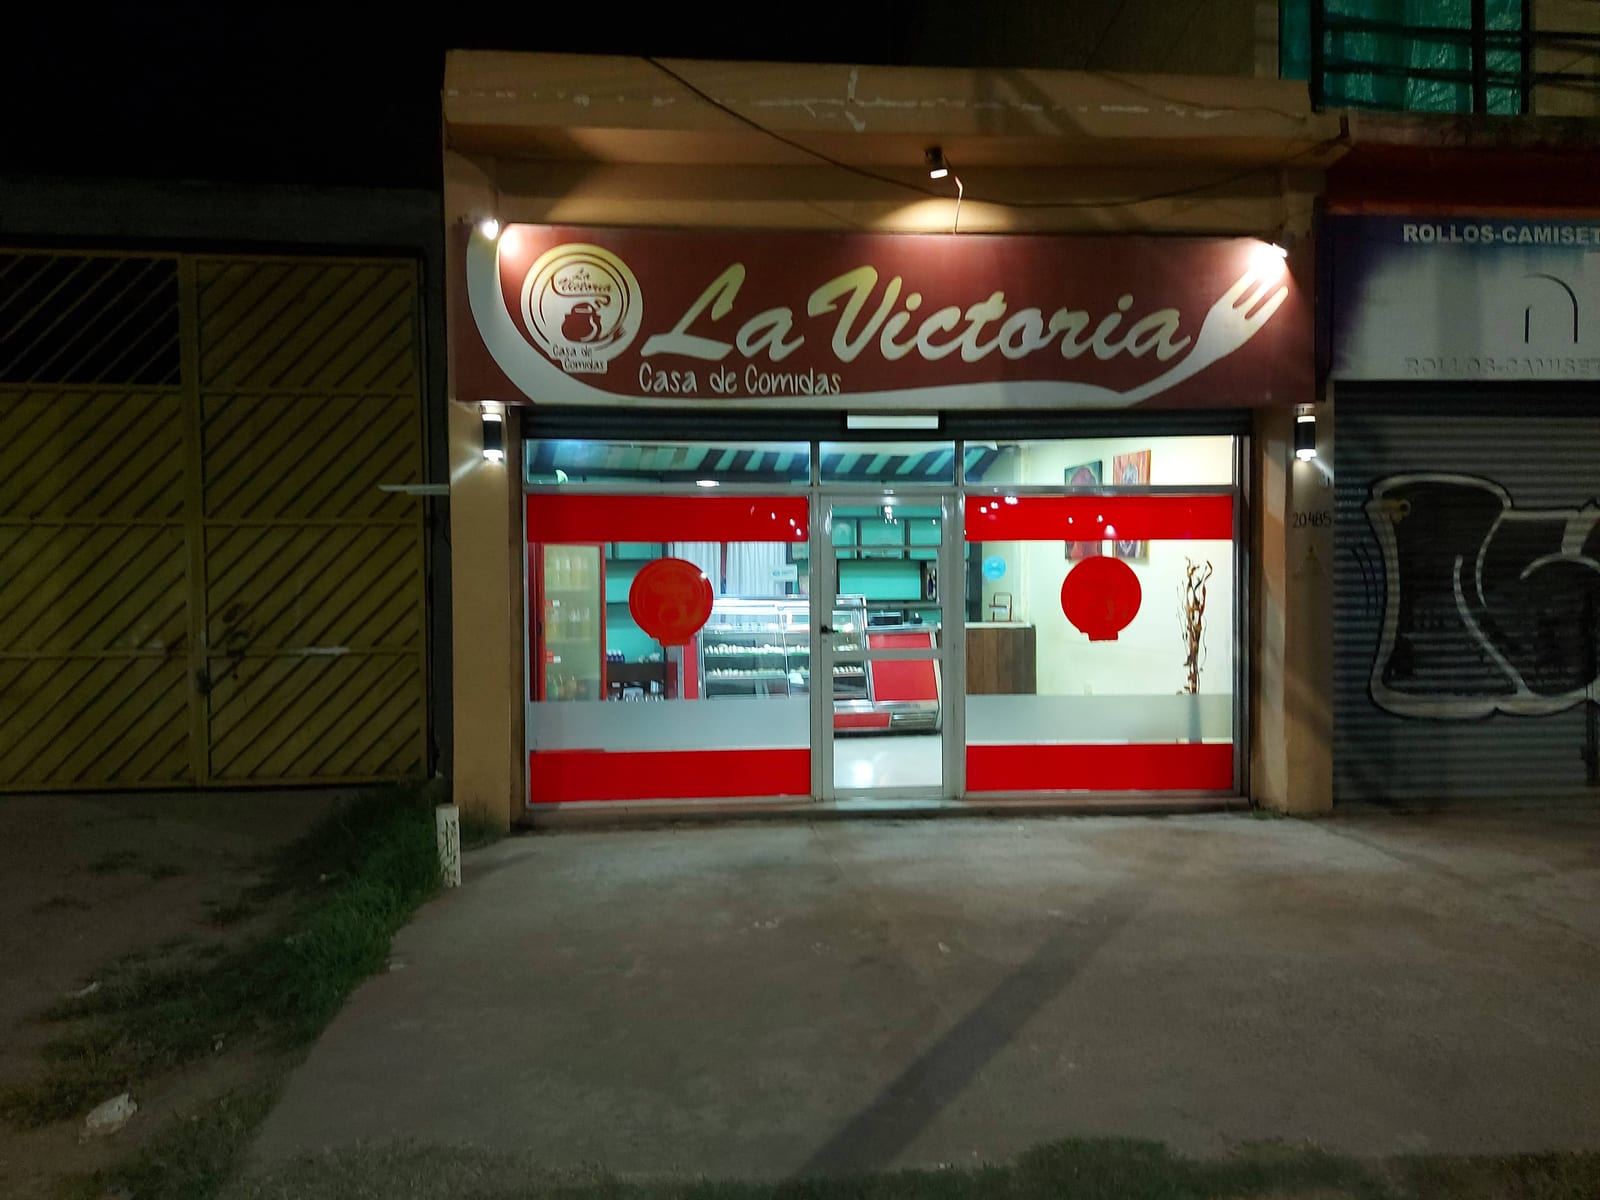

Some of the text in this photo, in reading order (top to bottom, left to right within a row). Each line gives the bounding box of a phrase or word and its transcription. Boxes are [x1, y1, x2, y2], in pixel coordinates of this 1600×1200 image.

[640, 262, 1191, 363] La Victoria
[553, 344, 577, 357] Casa
[639, 362, 842, 396] Casa de Comidas
[1292, 511, 1332, 528] 20485
